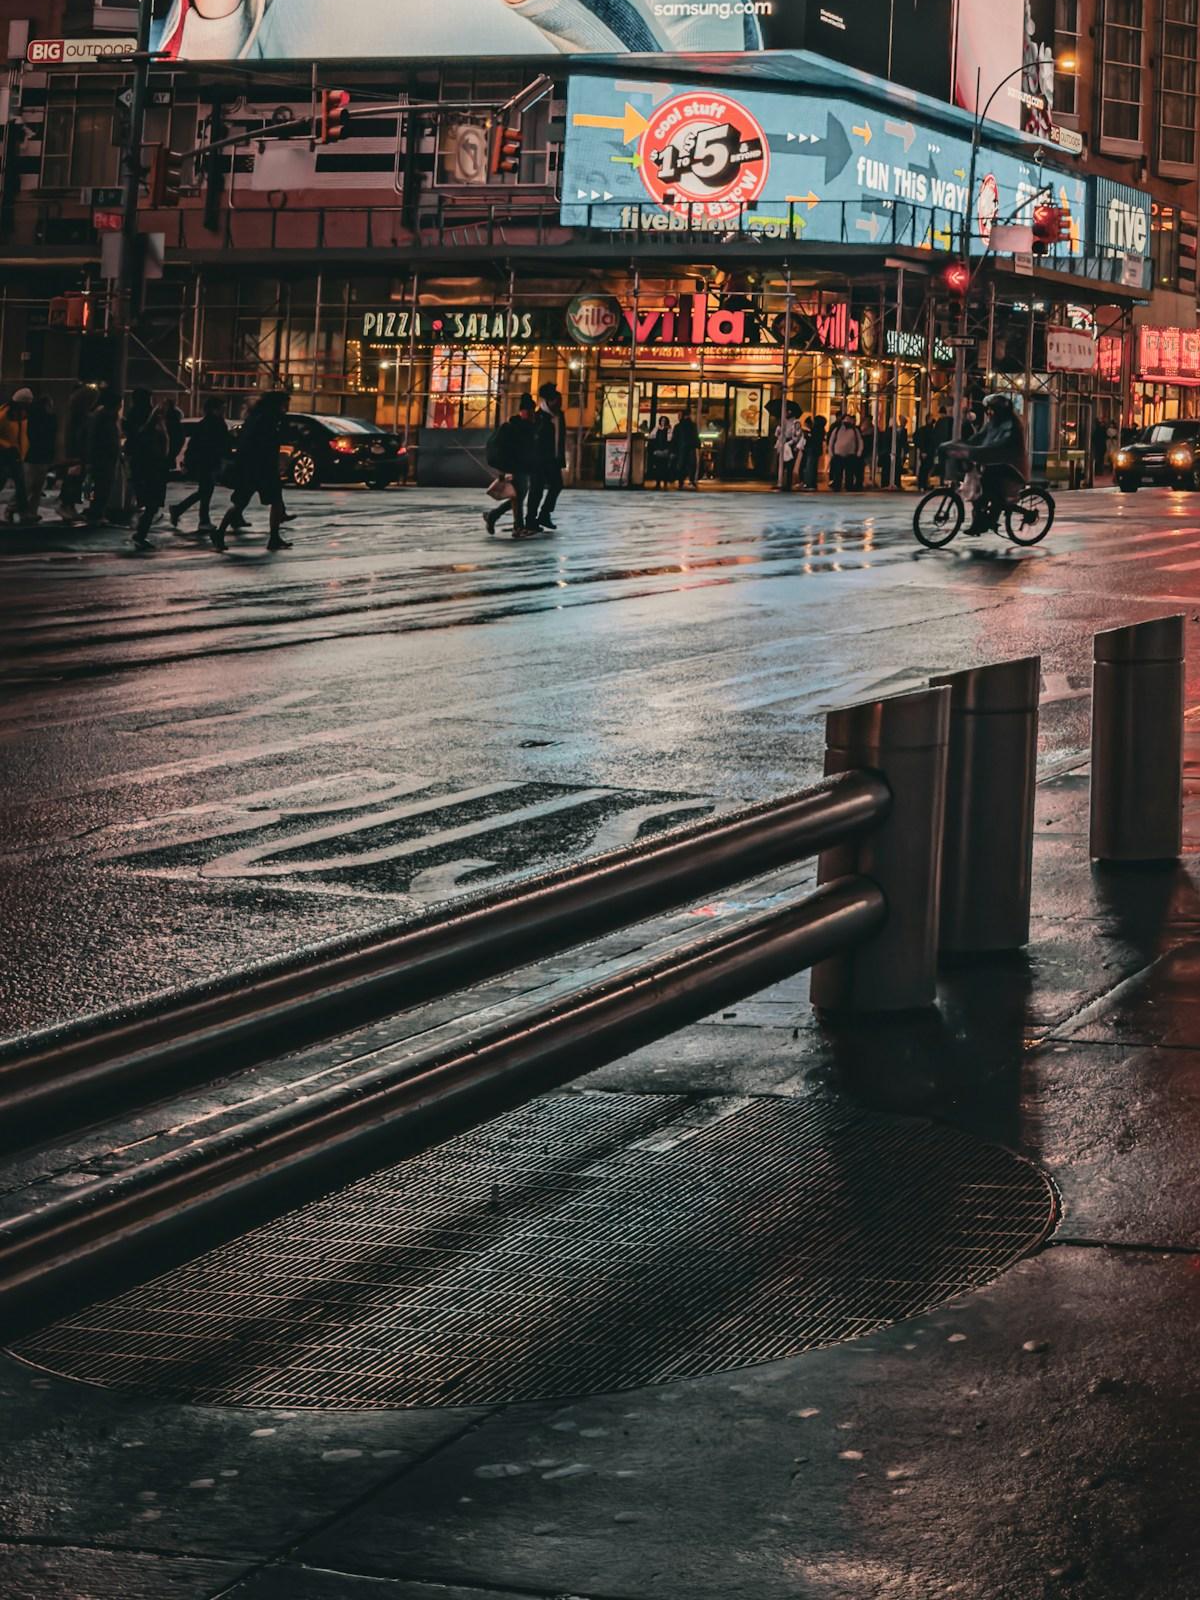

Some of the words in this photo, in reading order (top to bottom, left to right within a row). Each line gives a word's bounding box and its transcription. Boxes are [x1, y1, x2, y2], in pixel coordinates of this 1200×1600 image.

[654, 0, 772, 19] samsung.com
[32, 43, 61, 60] BIG
[654, 107, 682, 139] cool
[683, 102, 727, 119] stuff
[1108, 198, 1147, 253] five
[363, 312, 421, 338] PIZZA
[453, 312, 532, 339] SALADS
[571, 308, 614, 326] villa
[623, 293, 746, 345] villa
[816, 303, 859, 351] villa
